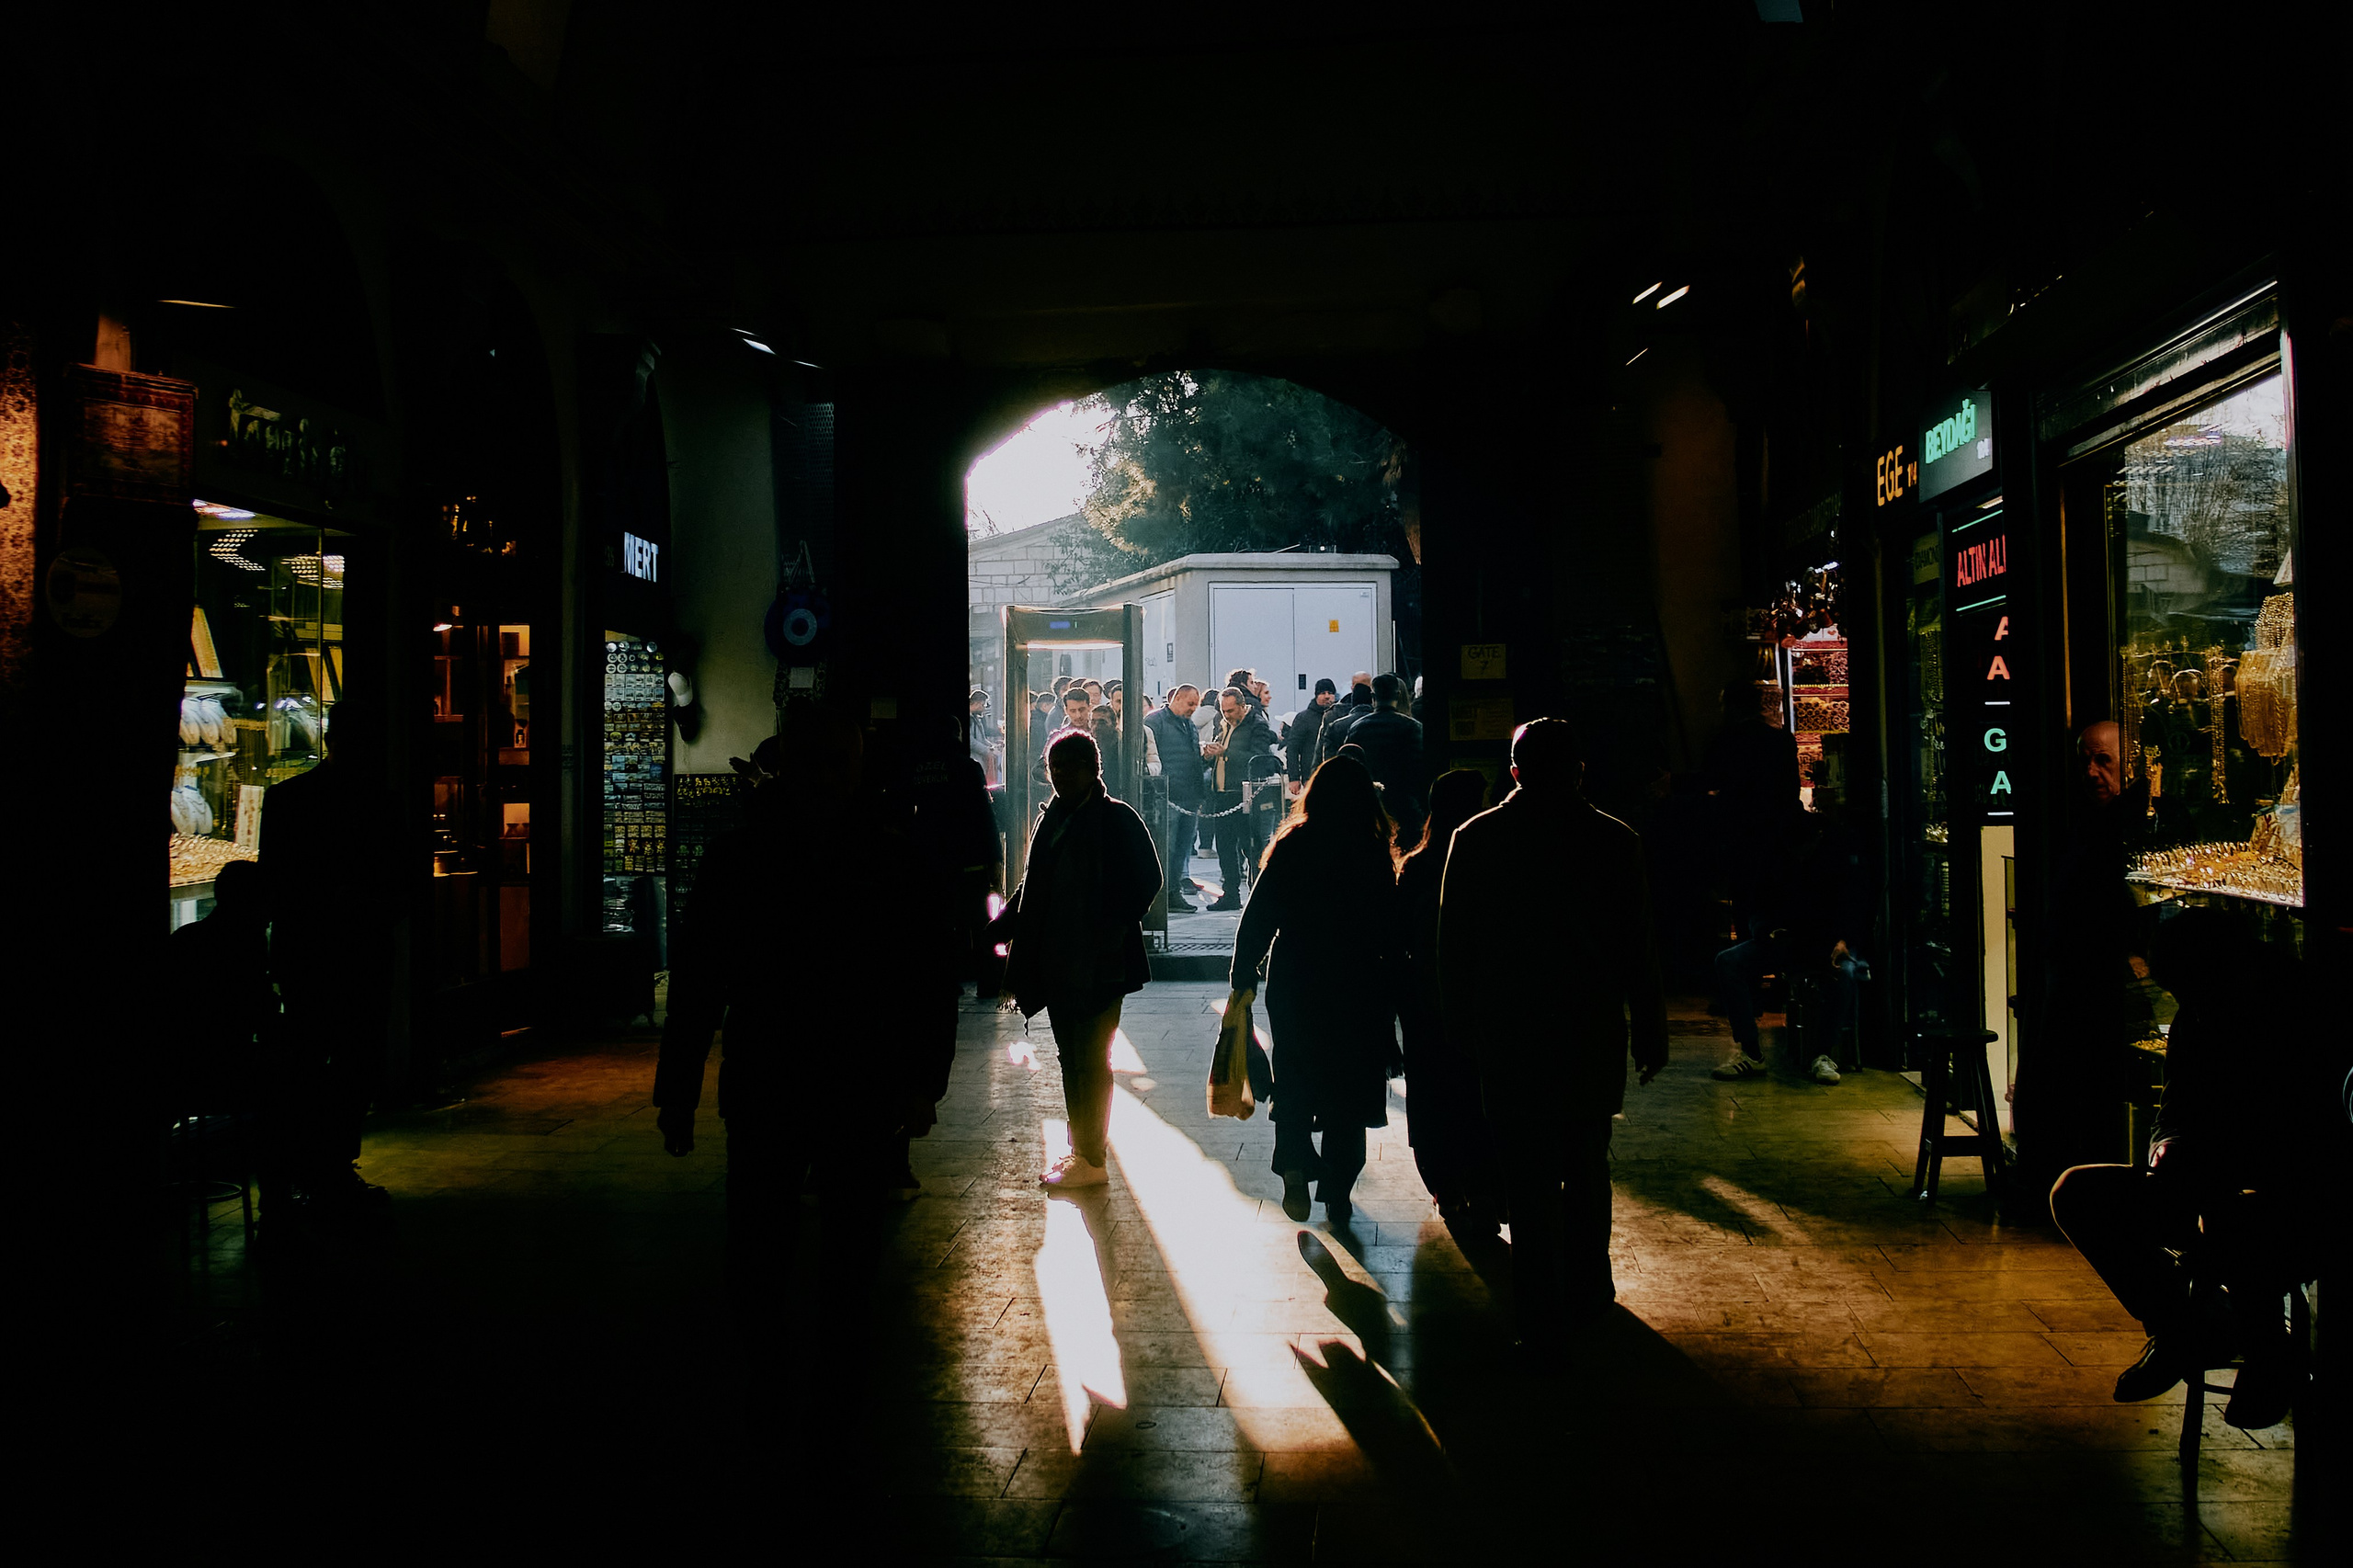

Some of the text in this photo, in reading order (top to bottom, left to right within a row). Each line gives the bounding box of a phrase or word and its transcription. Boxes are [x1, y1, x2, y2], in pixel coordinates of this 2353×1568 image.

[1877, 445, 1903, 506] EGE
[623, 530, 659, 584] MERT
[1956, 542, 1987, 588] ALTIN
[1467, 646, 1501, 660] GATE
